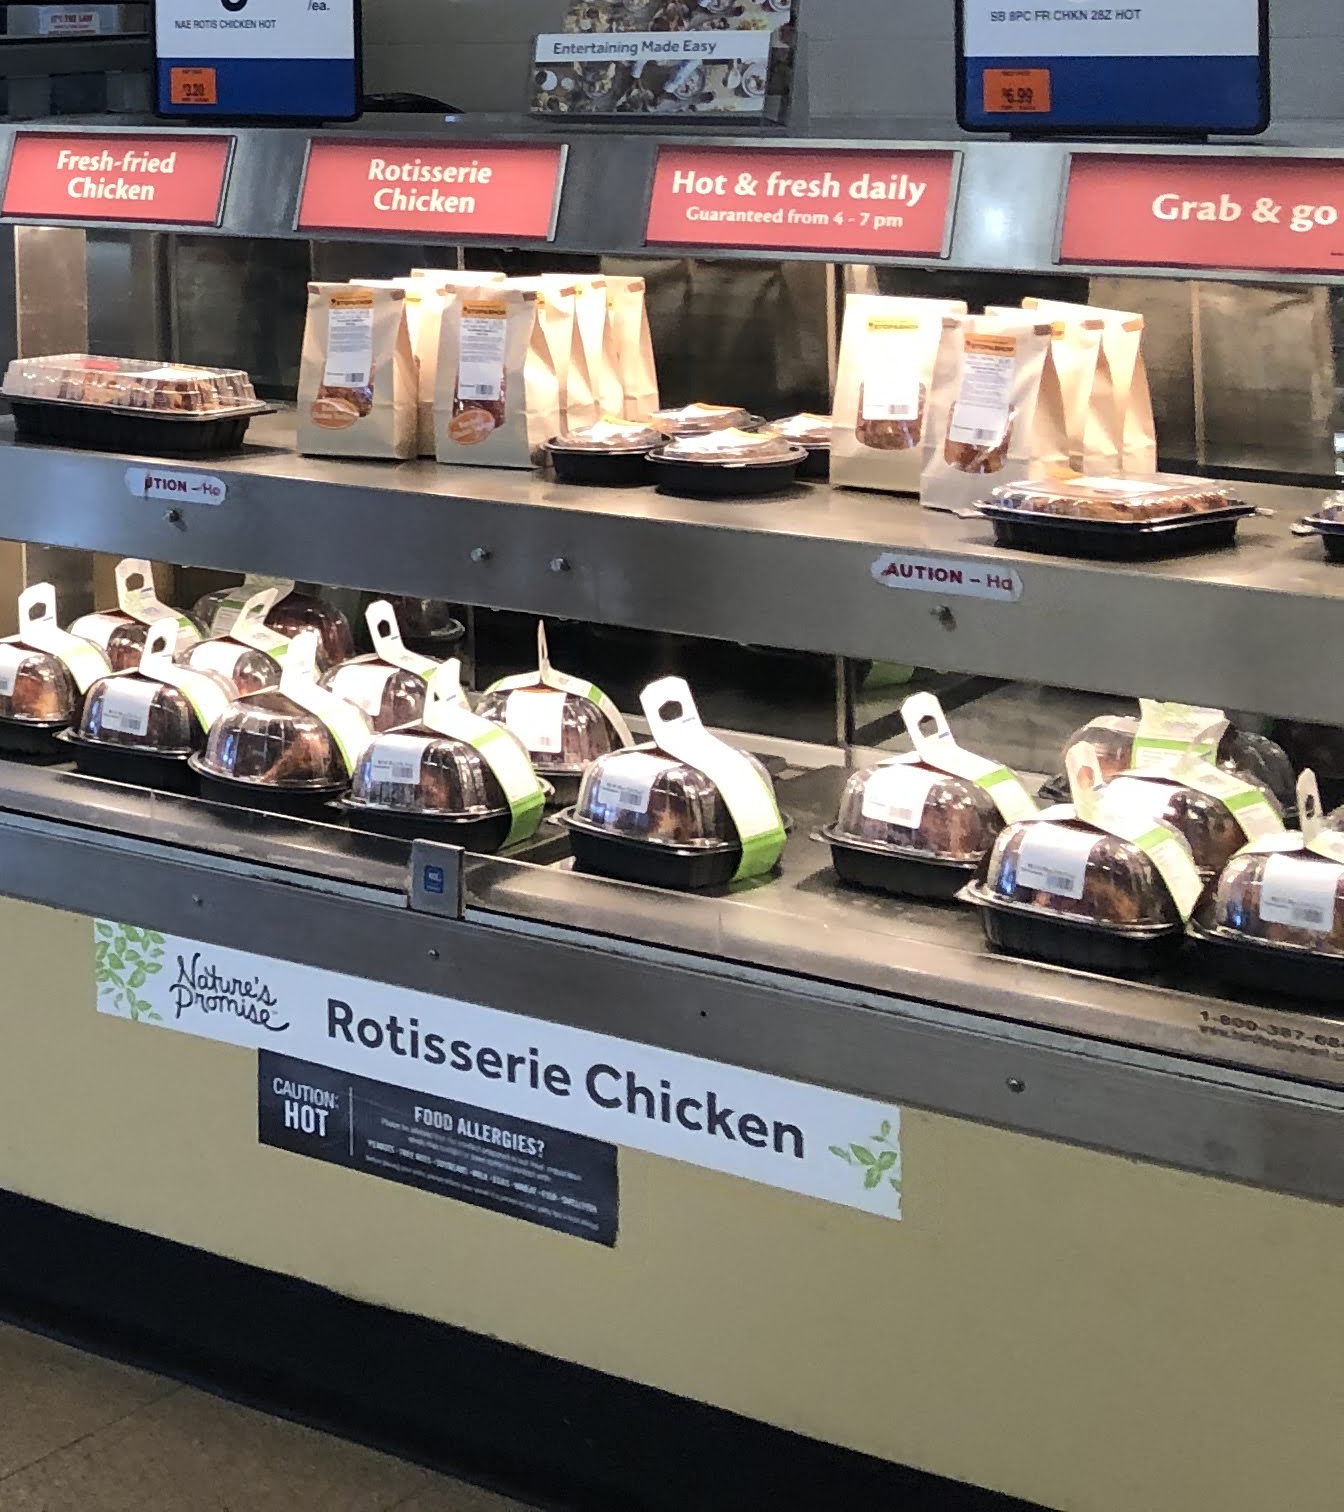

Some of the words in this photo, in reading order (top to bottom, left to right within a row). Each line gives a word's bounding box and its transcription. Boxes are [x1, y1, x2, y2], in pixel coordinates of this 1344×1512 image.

[219, 19, 257, 29] CHICKEN
[258, 19, 277, 29] HOT
[1053, 9, 1088, 20] CHKN
[1114, 8, 1142, 20] HOT
[553, 39, 638, 56] Entertaining
[641, 41, 679, 53] Made
[683, 40, 716, 55] Easy
[56, 149, 176, 175] Fresh-fried
[367, 158, 493, 184] Rotisserie
[67, 177, 155, 201] Chicken
[373, 187, 476, 215] Chicken
[671, 170, 729, 196] Hot
[734, 172, 757, 197] &
[764, 170, 841, 200] fresh
[848, 172, 927, 207] daily
[685, 205, 784, 226] Guaranteed
[787, 206, 829, 228] from
[832, 212, 845, 227] 4
[859, 212, 870, 228] 7
[874, 215, 904, 231] pm
[1152, 193, 1242, 221] Grab
[1251, 197, 1282, 224] &
[1289, 205, 1338, 232] go
[177, 952, 277, 1006] Nature's
[169, 983, 290, 1031] Promise
[272, 1076, 340, 1110] CAUTION:
[326, 997, 572, 1097] Rotisserie
[585, 1063, 806, 1160] Chicken
[284, 1100, 329, 1138] HOT
[414, 1106, 453, 1131] FOOD
[457, 1118, 545, 1158] ALLERGIES?
